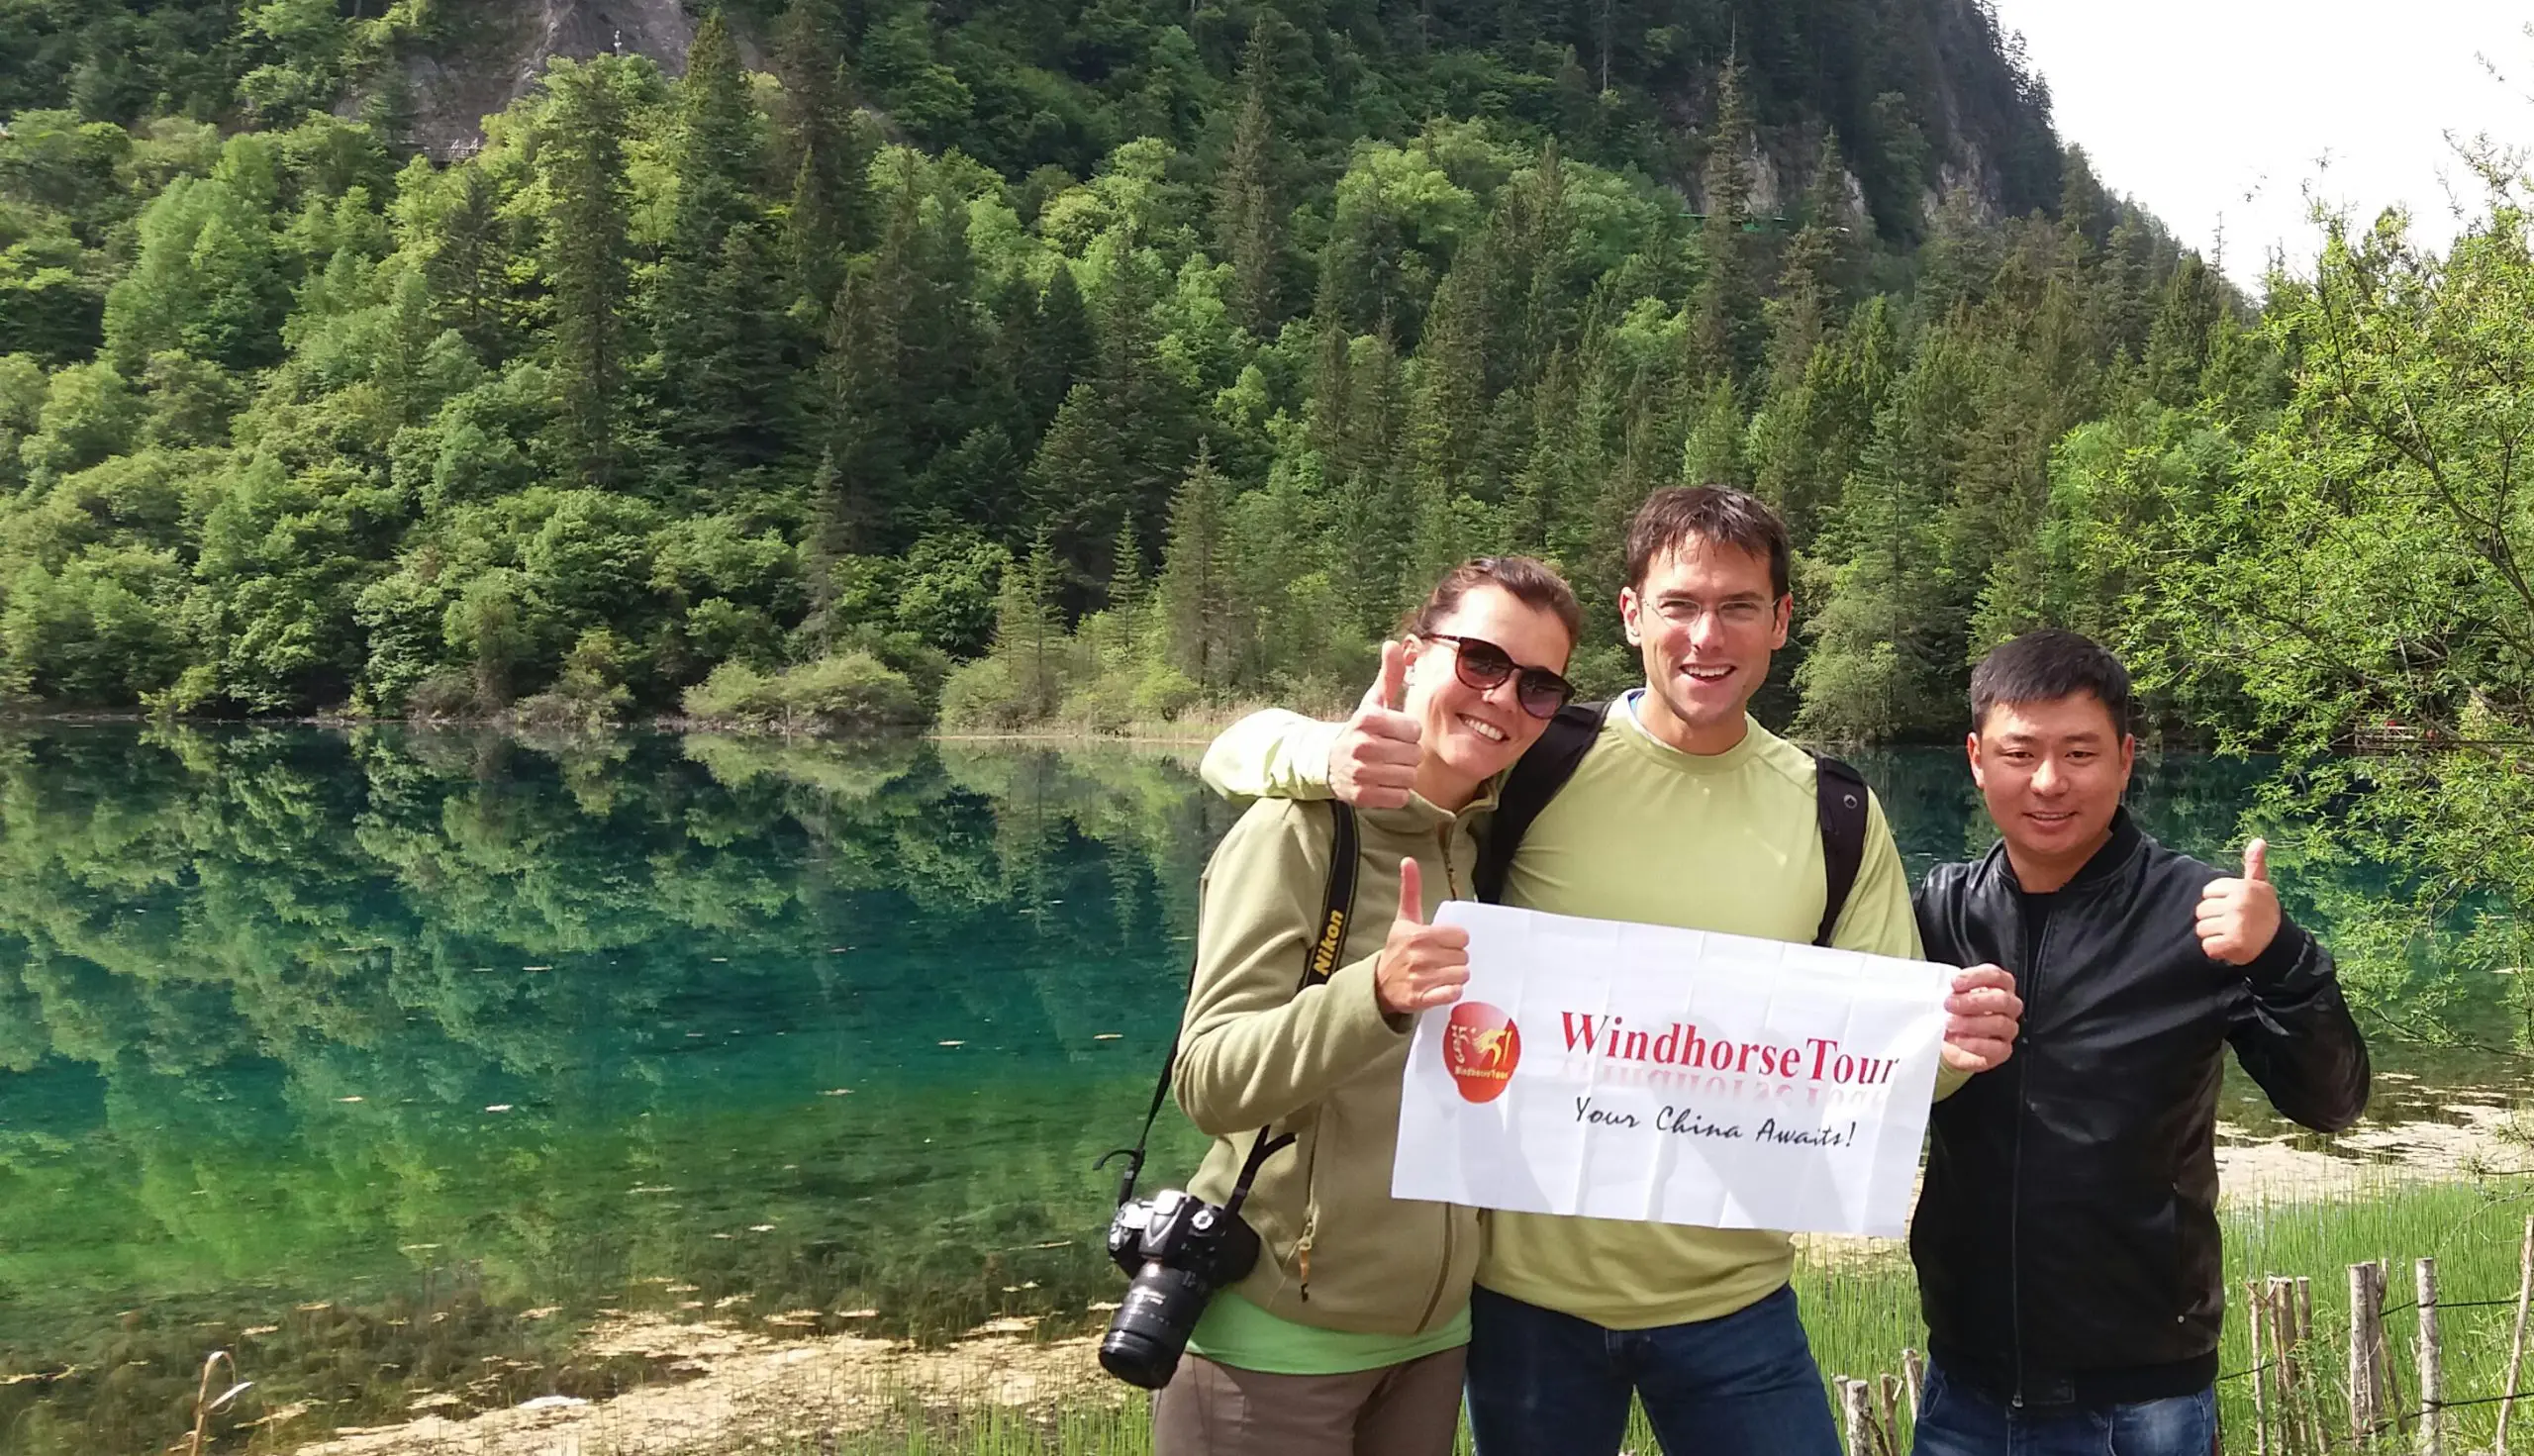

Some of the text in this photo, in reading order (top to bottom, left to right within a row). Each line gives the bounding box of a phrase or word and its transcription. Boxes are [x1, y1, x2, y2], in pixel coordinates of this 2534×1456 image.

[1314, 911, 1343, 975] Nikon
[1561, 1011, 1900, 1085] WindhorseTour
[1576, 1096, 1857, 1147] Your China Awaits!
